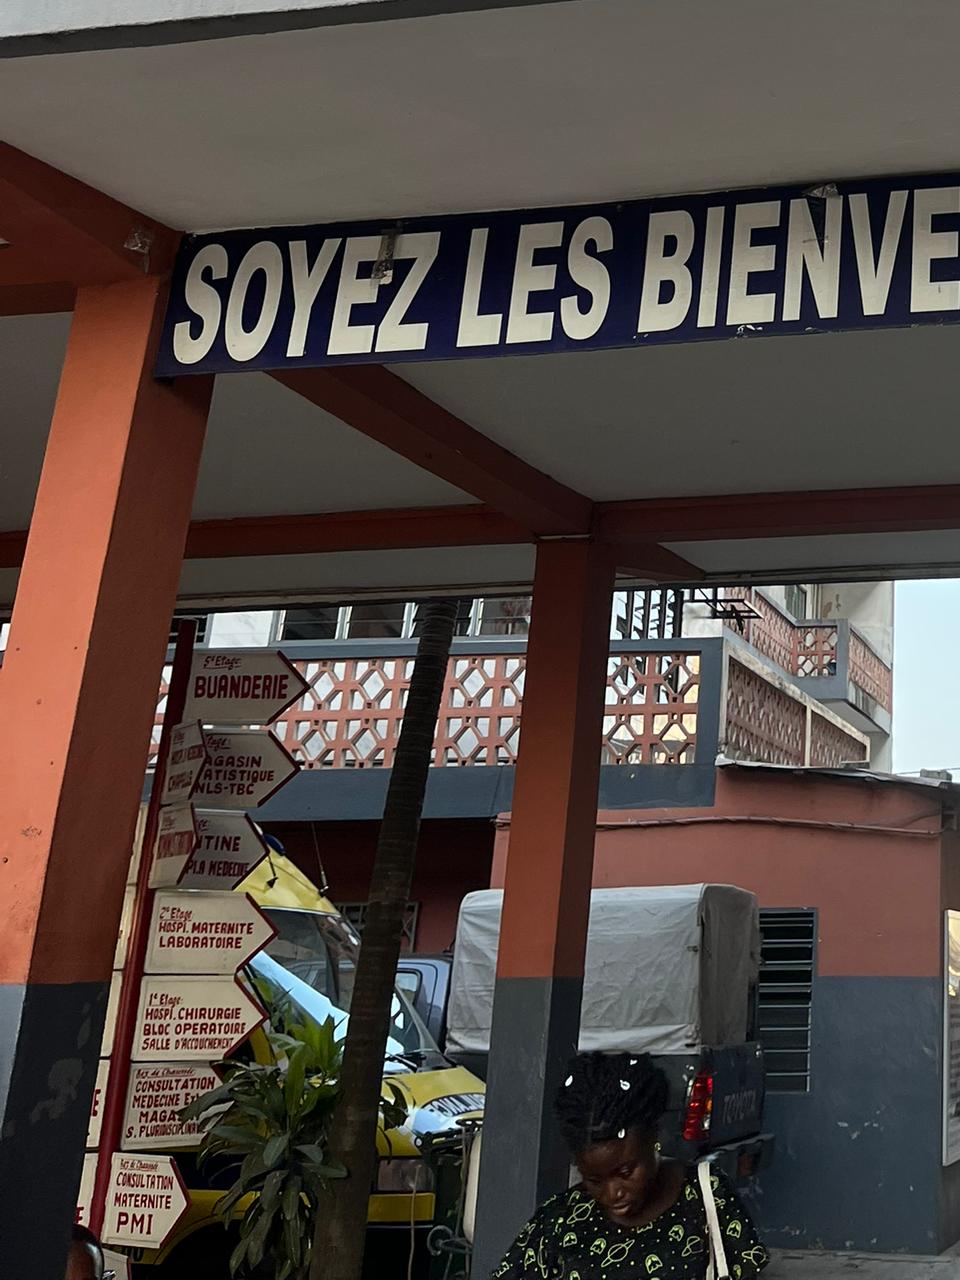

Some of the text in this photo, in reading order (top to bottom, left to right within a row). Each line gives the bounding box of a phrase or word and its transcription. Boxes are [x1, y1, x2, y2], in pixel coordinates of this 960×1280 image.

[173, 231, 441, 367] SOYEZ
[455, 215, 616, 349] LES
[194, 675, 289, 699] BUANDERIE
[205, 756, 262, 768] AGASIN
[204, 769, 274, 782] ATISTIQUE
[195, 782, 254, 795] NLS-TBC
[191, 922, 254, 934] MATERNITE
[159, 936, 243, 949] LABORATOIRE
[178, 1008, 241, 1020] CHIRURGIE
[143, 1022, 246, 1036] BLOC OPERATOIRE
[142, 1038, 170, 1051] SALLE
[135, 1076, 216, 1093] CONSULTATION
[132, 1094, 180, 1108] MEDECINE
[126, 1126, 136, 1138] S.
[116, 1172, 173, 1190] CONSULTATION
[114, 1193, 171, 1209] MATERNITE
[116, 1212, 153, 1235] PMI
